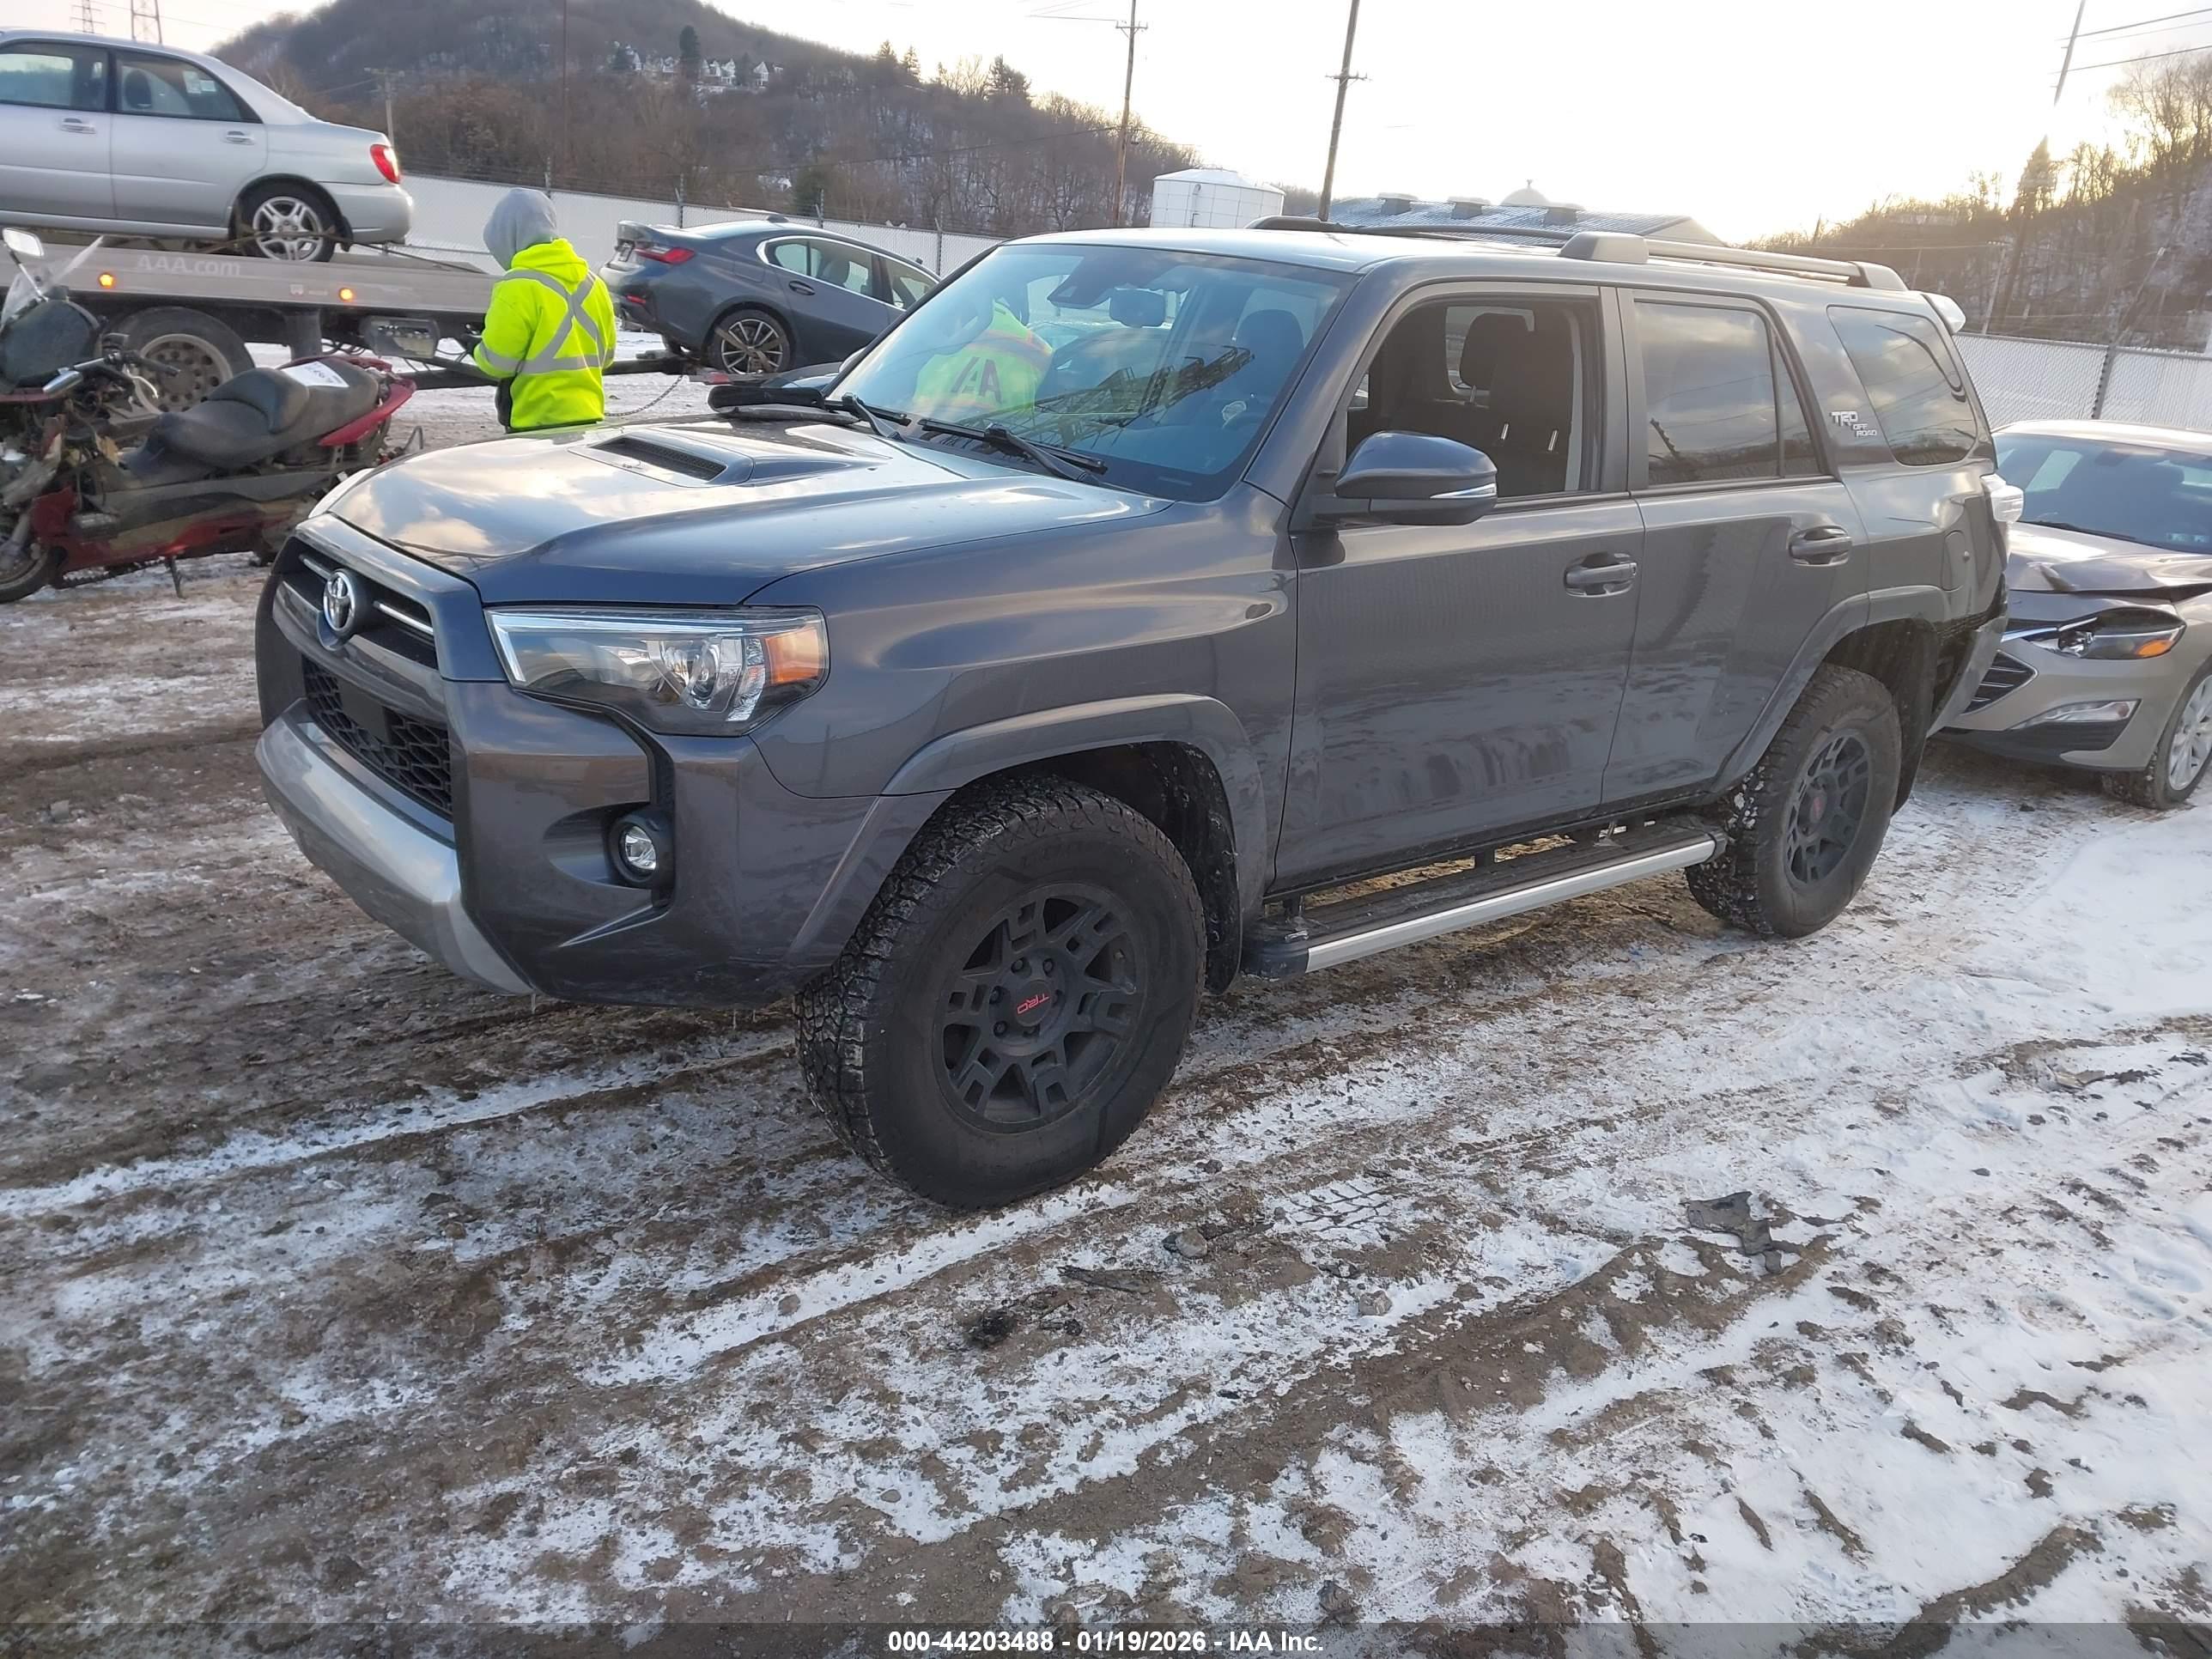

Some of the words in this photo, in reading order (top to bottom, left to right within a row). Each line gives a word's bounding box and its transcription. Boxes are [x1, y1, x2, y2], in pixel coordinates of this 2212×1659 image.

[137, 253, 241, 276] AAA.com
[1830, 410, 1858, 427] TRD
[1017, 993, 1049, 1015] TRD
